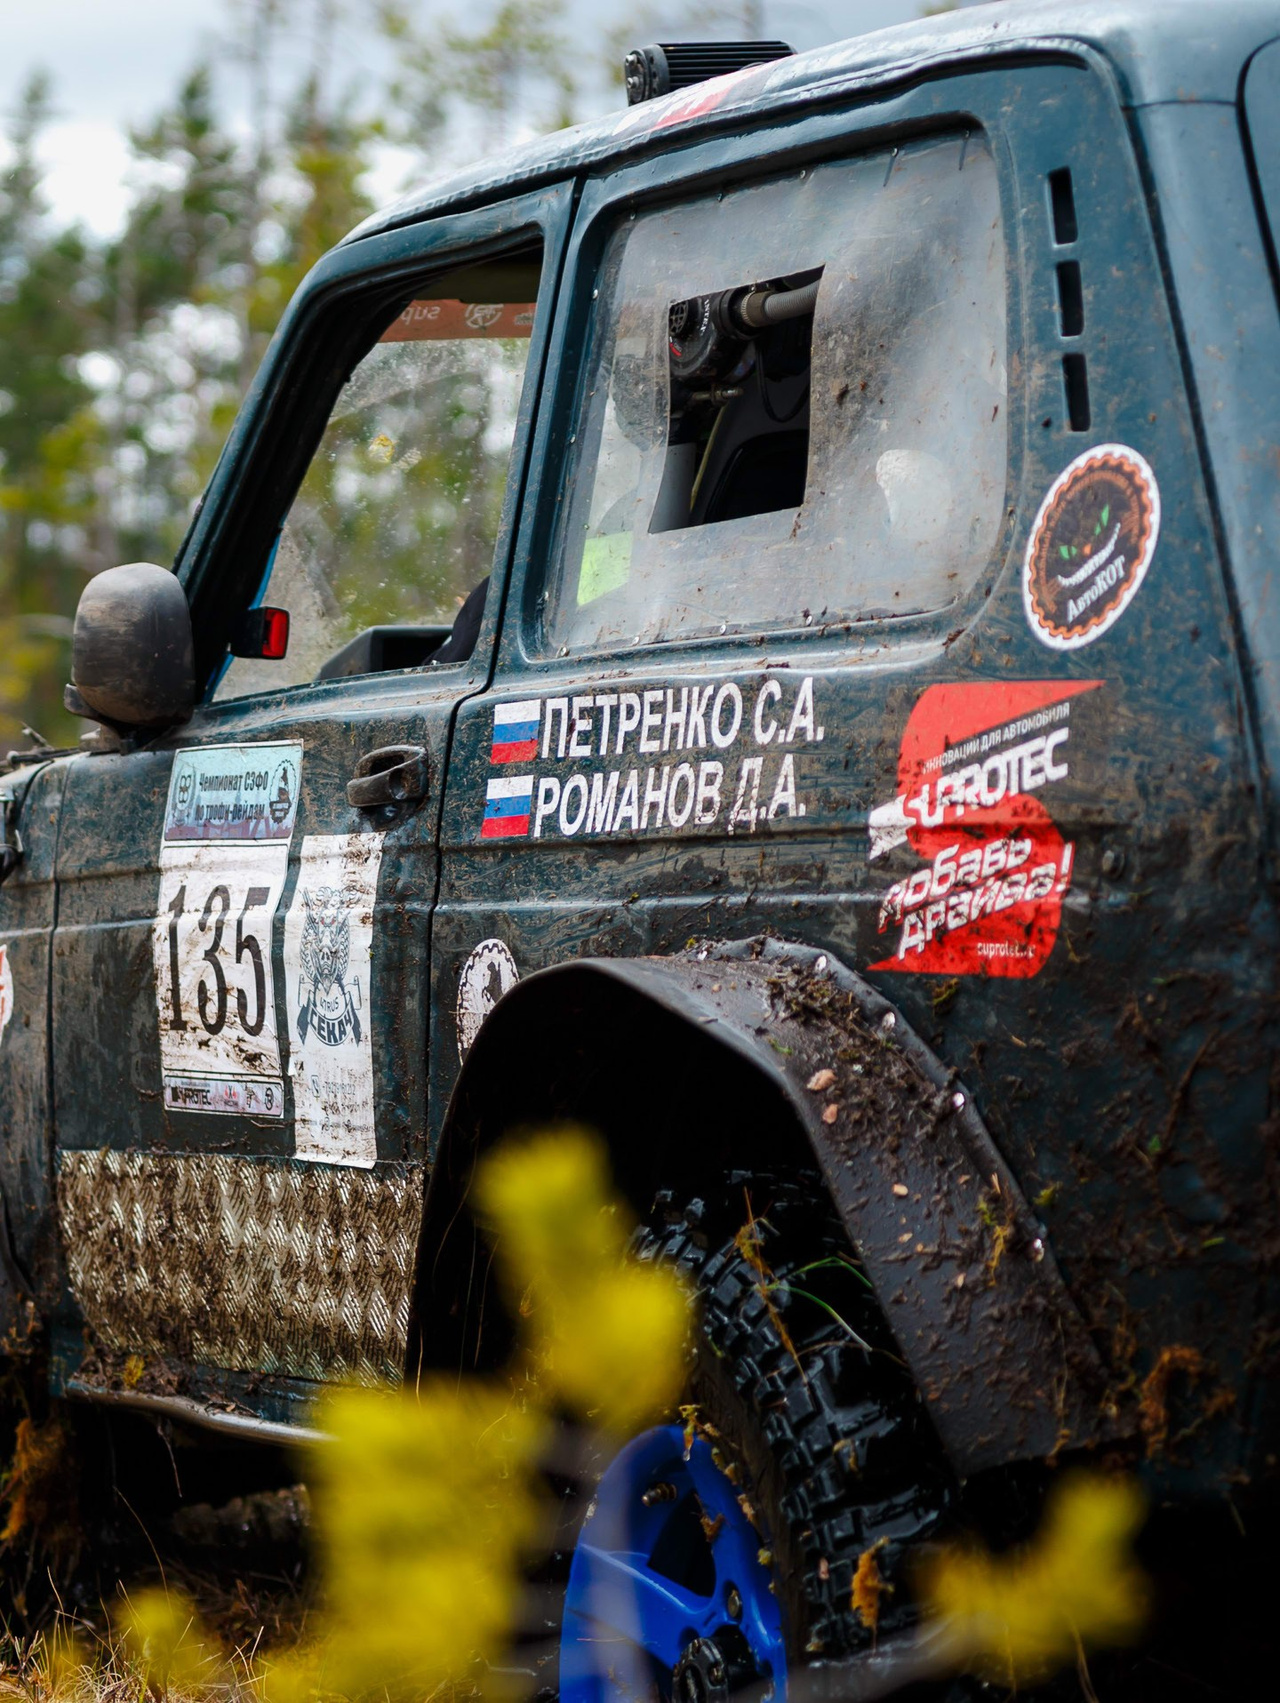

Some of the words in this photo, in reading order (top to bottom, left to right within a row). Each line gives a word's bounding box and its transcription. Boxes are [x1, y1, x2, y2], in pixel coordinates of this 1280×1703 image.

[541, 682, 743, 759] ПЕТРЕНКО
[754, 677, 824, 745] С.А.
[981, 729, 1002, 752] ДЛЯ
[1003, 702, 1070, 741] АВТОМОБИЛЯ
[199, 773, 243, 791] Чемпионат
[244, 771, 268, 791] СЗФО
[206, 800, 265, 822] трофи-рейдам
[533, 760, 724, 838] РОМАНОВ
[727, 754, 806, 835] Д.А.
[869, 727, 1069, 860] SUPROTEC
[168, 884, 270, 1036] 135
[309, 1008, 352, 1043] СЕКАЧ
